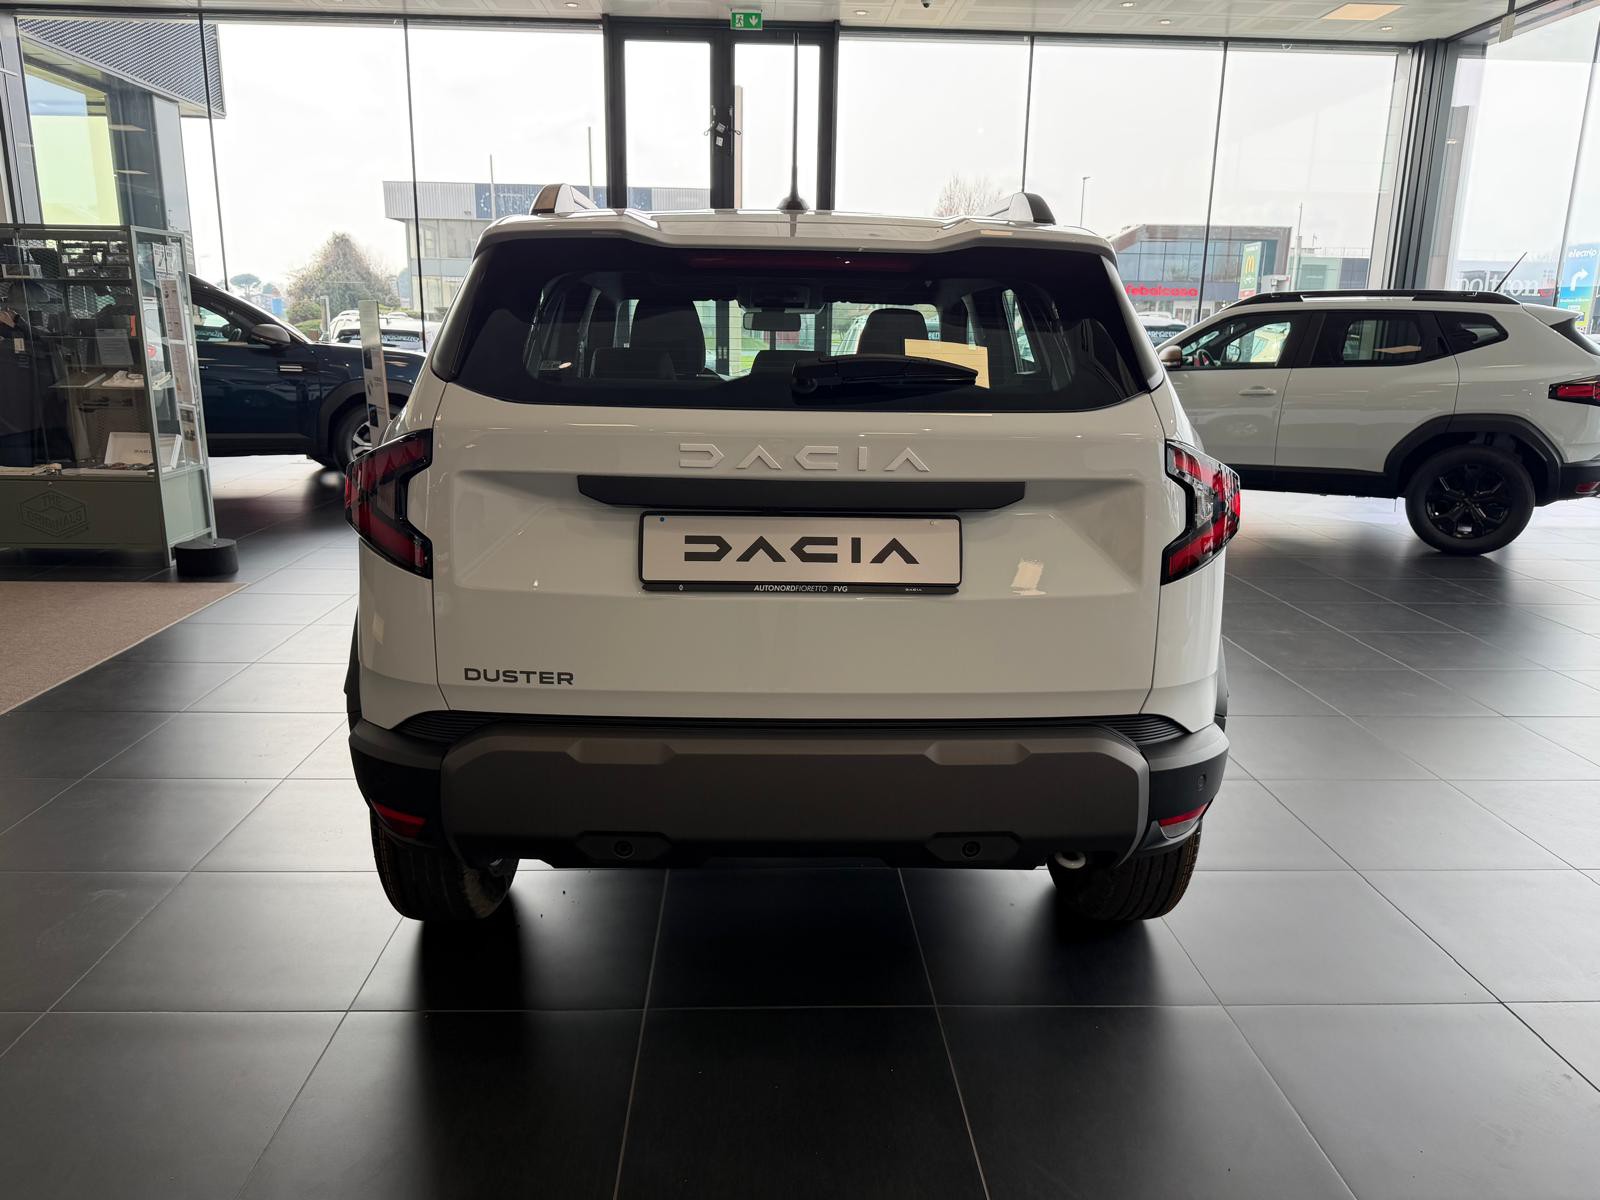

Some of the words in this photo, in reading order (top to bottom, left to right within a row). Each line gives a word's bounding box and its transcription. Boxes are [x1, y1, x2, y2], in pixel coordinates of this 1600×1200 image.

[679, 443, 930, 472] DACIA
[684, 535, 920, 564] DACIA
[833, 585, 848, 593] FVG
[464, 667, 574, 685] DUSTER
